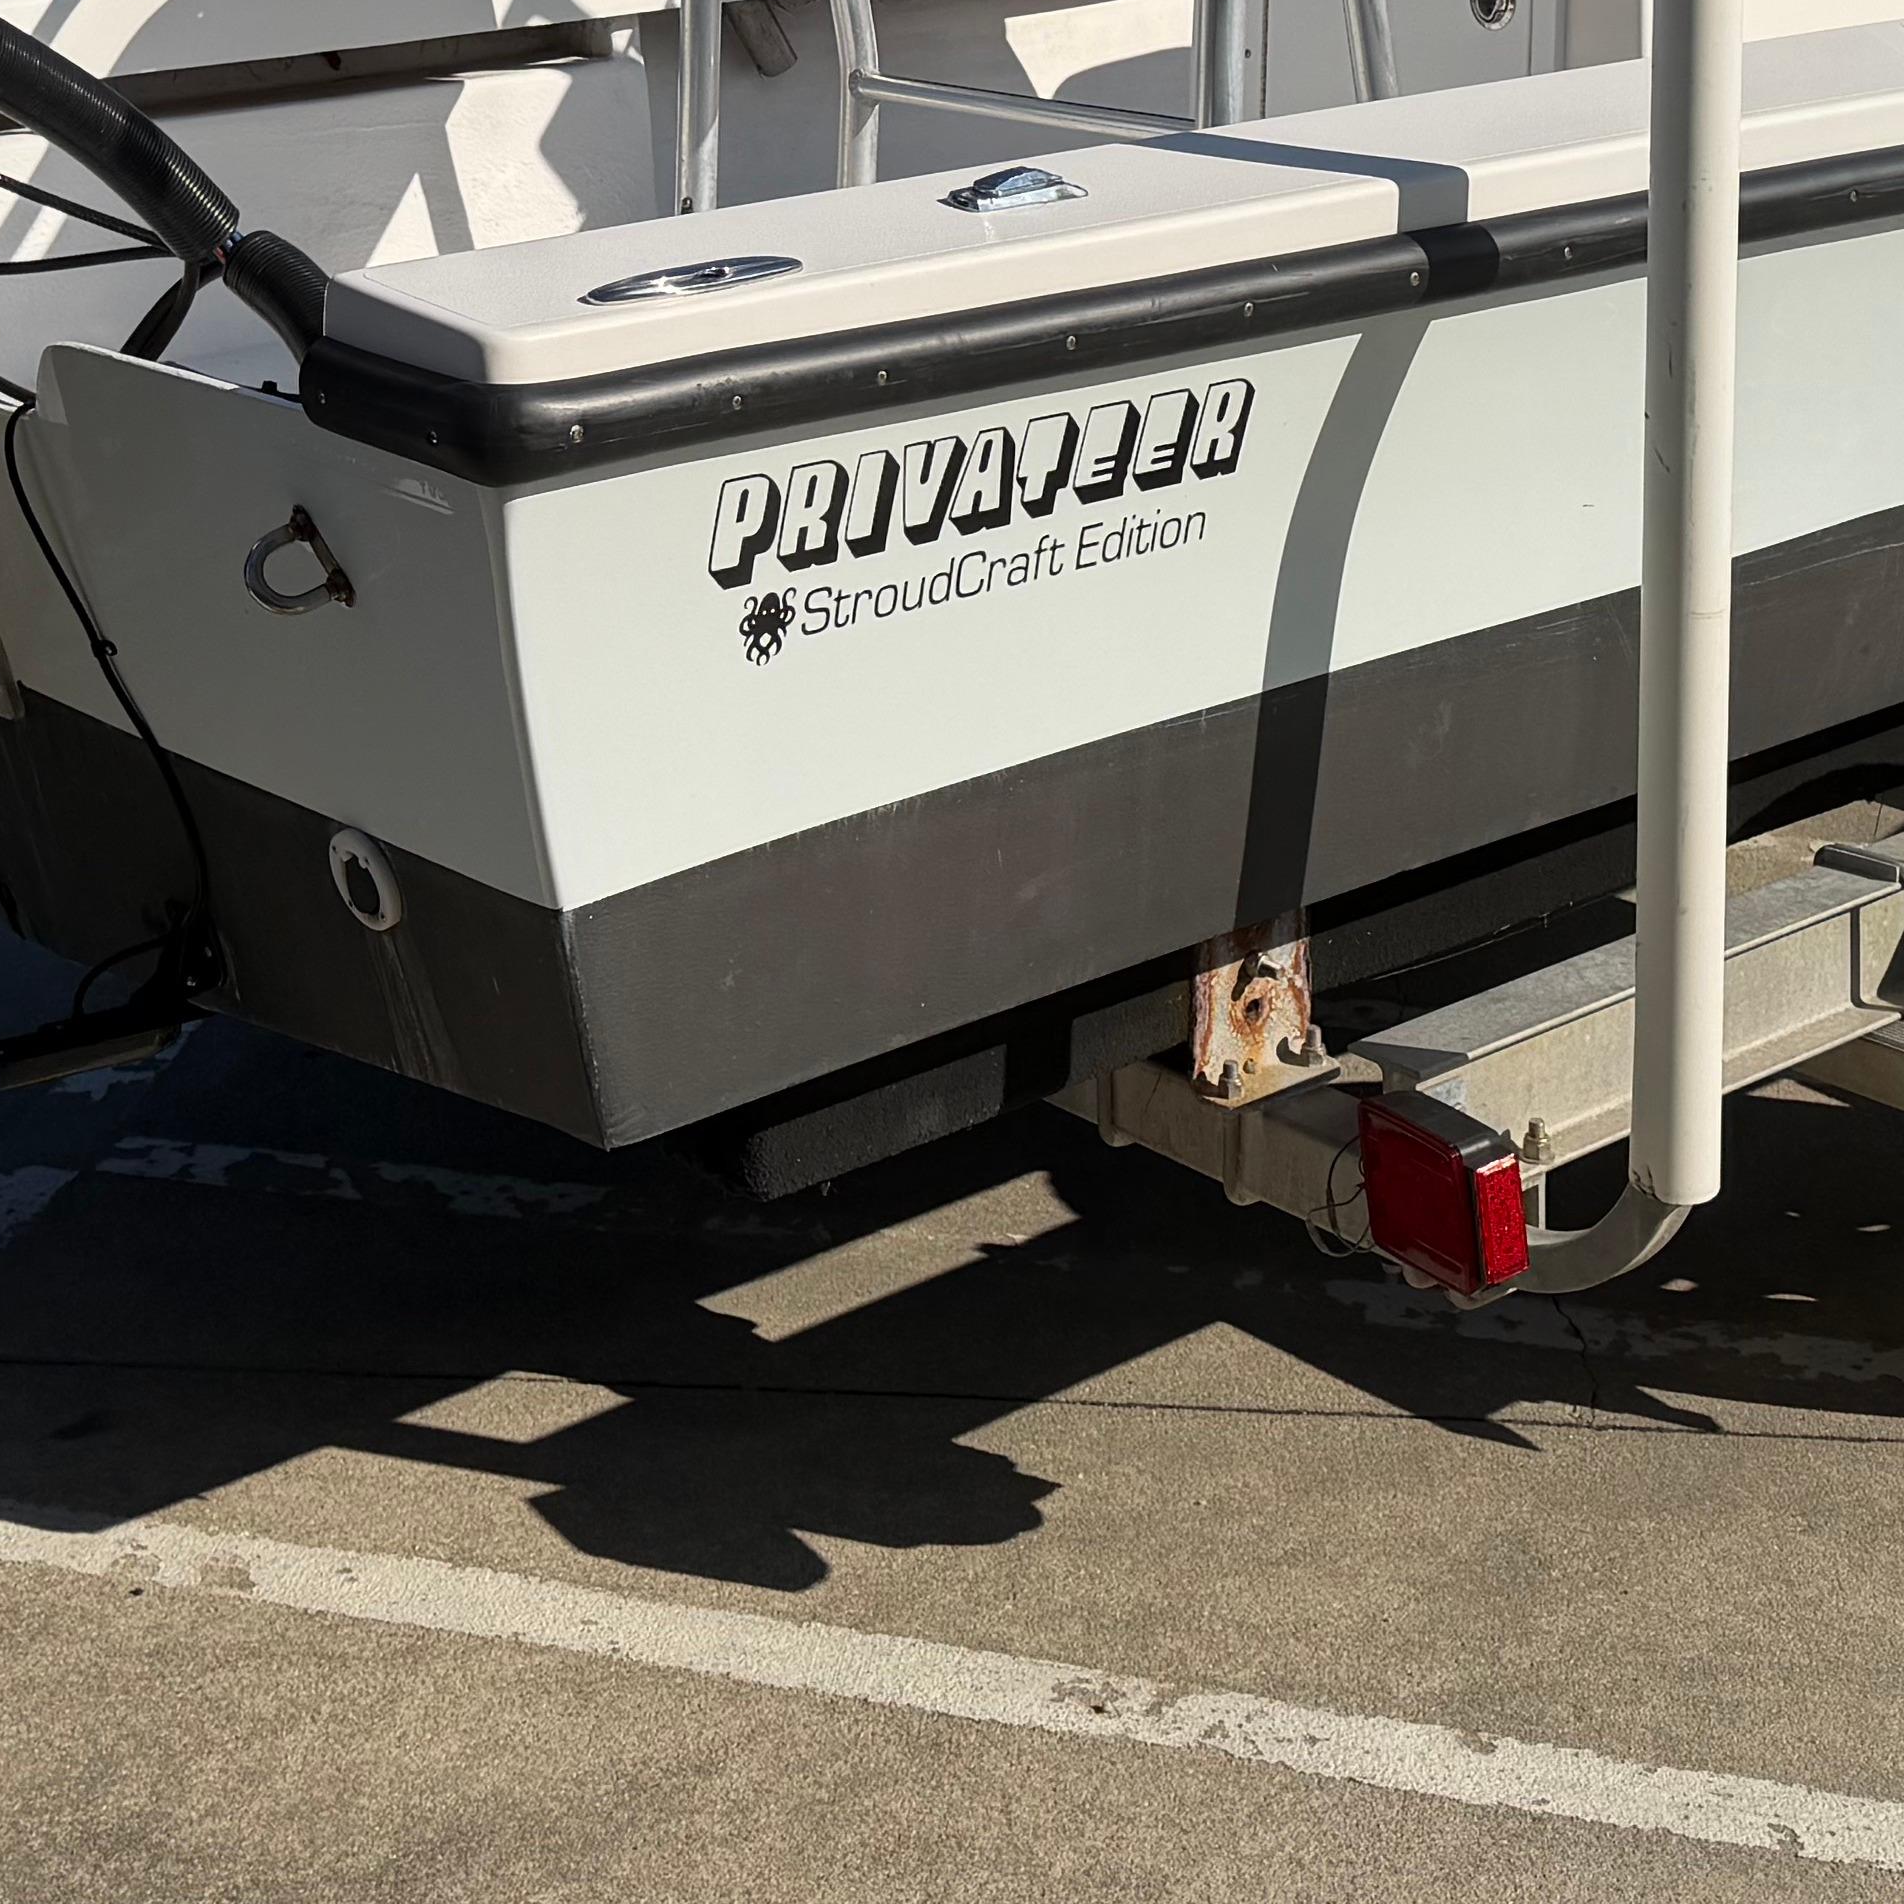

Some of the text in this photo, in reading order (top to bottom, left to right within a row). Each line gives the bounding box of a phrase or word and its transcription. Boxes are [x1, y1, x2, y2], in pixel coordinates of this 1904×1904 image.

[708, 377, 1256, 590] PRIVATEER
[800, 508, 1207, 637] StroudCraft Edition
